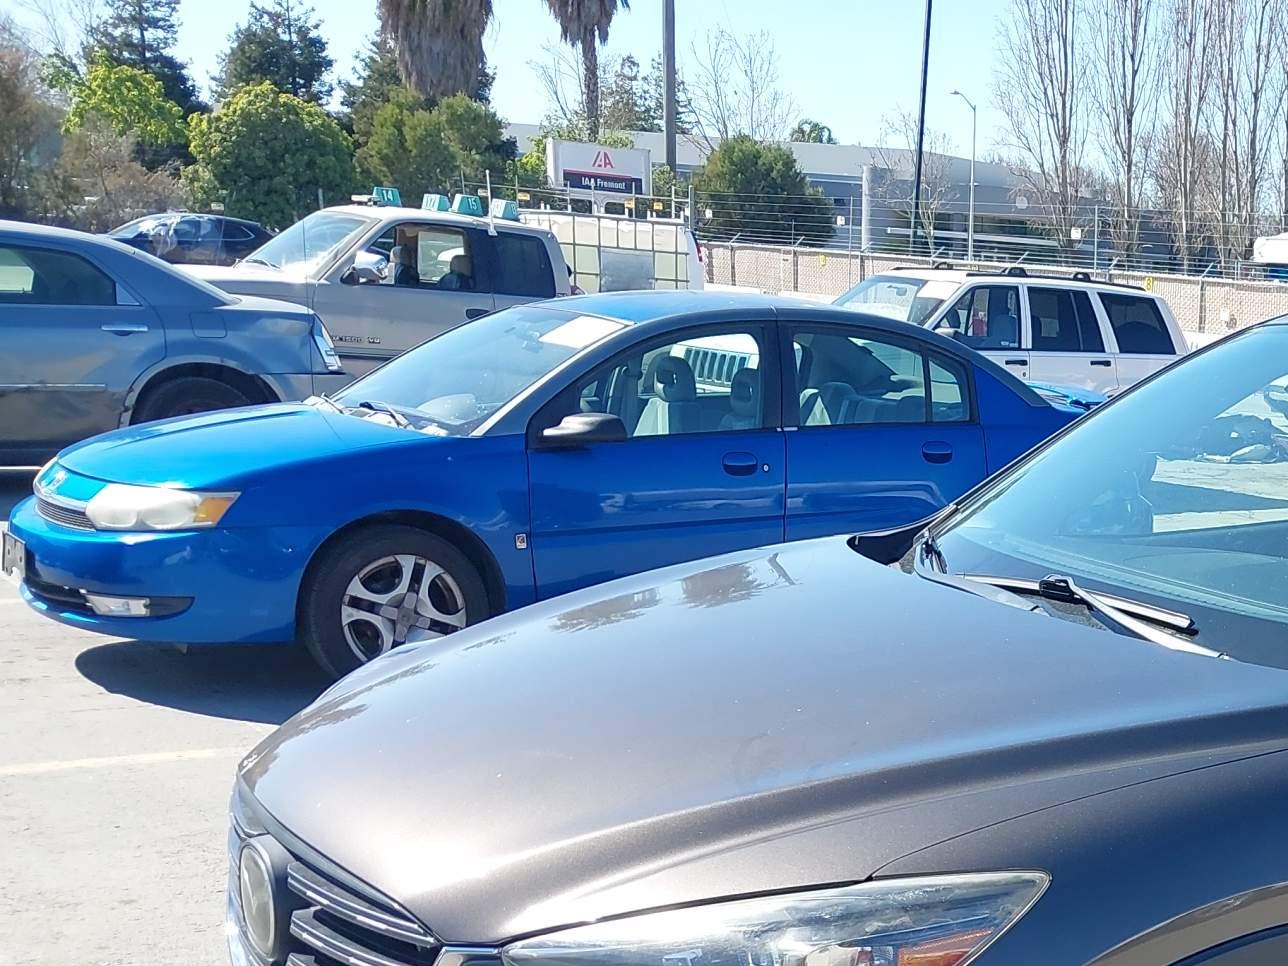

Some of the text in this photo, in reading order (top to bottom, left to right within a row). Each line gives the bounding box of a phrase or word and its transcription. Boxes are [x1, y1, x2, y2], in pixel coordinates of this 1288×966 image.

[597, 179, 626, 190] Fremont
[382, 190, 394, 201] 14
[467, 198, 478, 210] 15
